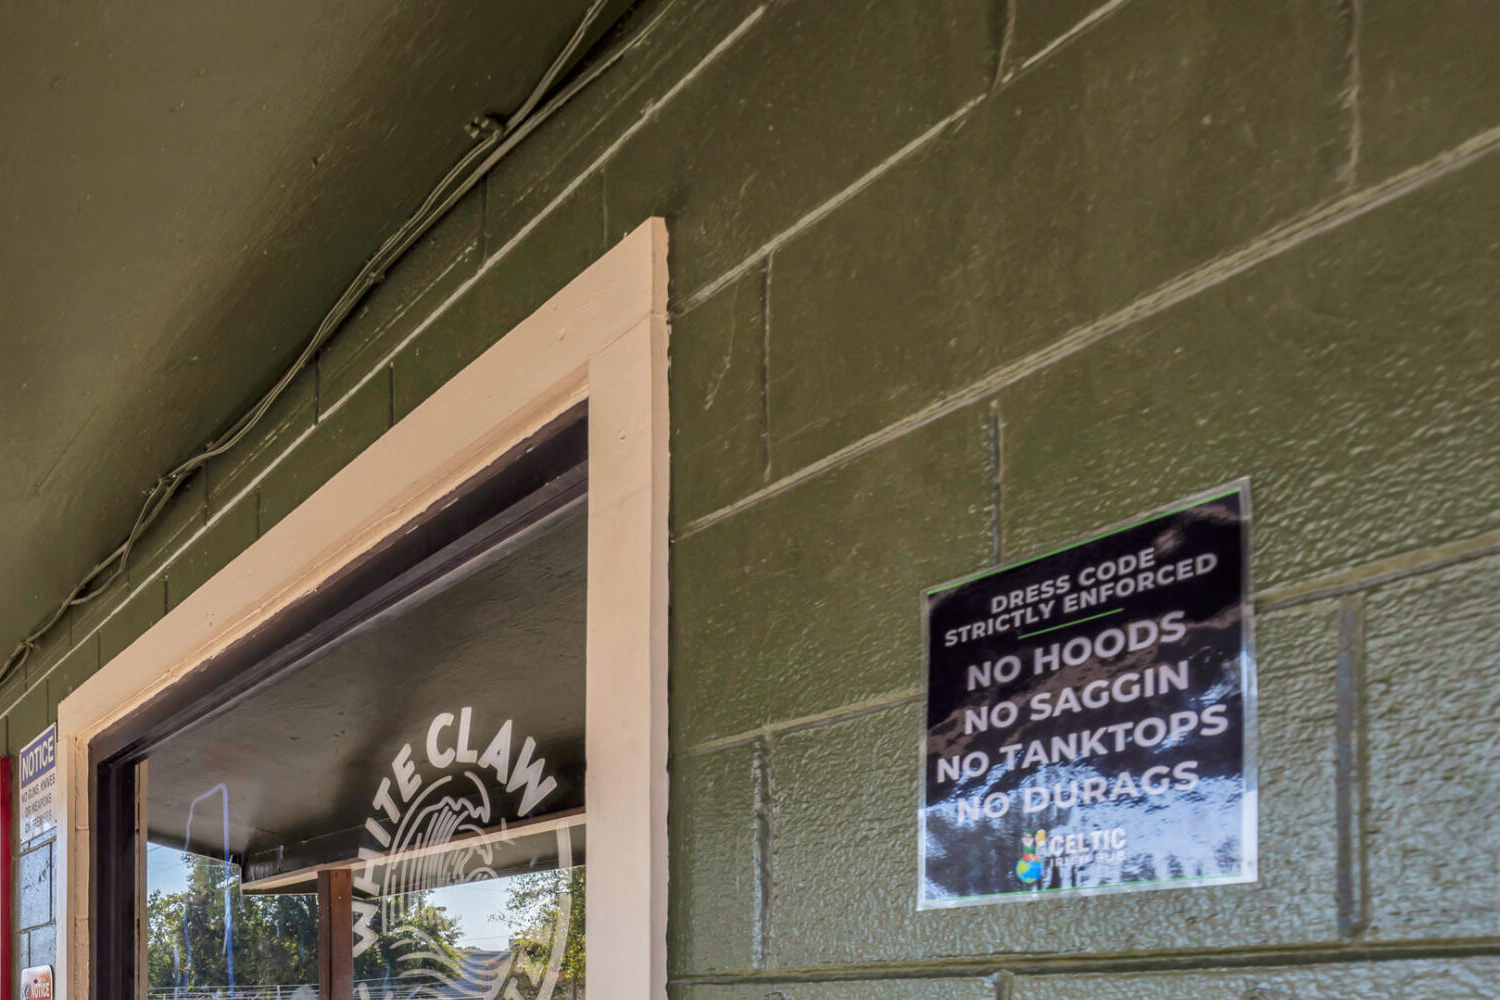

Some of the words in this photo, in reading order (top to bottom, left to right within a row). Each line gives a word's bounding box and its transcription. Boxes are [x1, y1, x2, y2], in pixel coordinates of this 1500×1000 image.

[944, 599, 1058, 648] STRICTLY
[1063, 552, 1219, 614] ENFORCED
[990, 573, 1071, 615] DRESS
[1078, 547, 1156, 587] CODE
[966, 654, 1022, 692] NO
[1034, 610, 1188, 675] HOODS
[963, 700, 1019, 736] NO
[1028, 660, 1190, 723] SAGGIN
[22, 735, 54, 782] NOTICE
[936, 750, 990, 784] NO
[999, 703, 1230, 772] TANKTOPS
[956, 791, 1011, 824] NO
[1023, 760, 1200, 815] DURAGS
[352, 743, 422, 958] WHITE
[426, 706, 558, 818] CLAW
[1049, 826, 1126, 857] CELTIC
[31, 982, 50, 999] NOTICE
